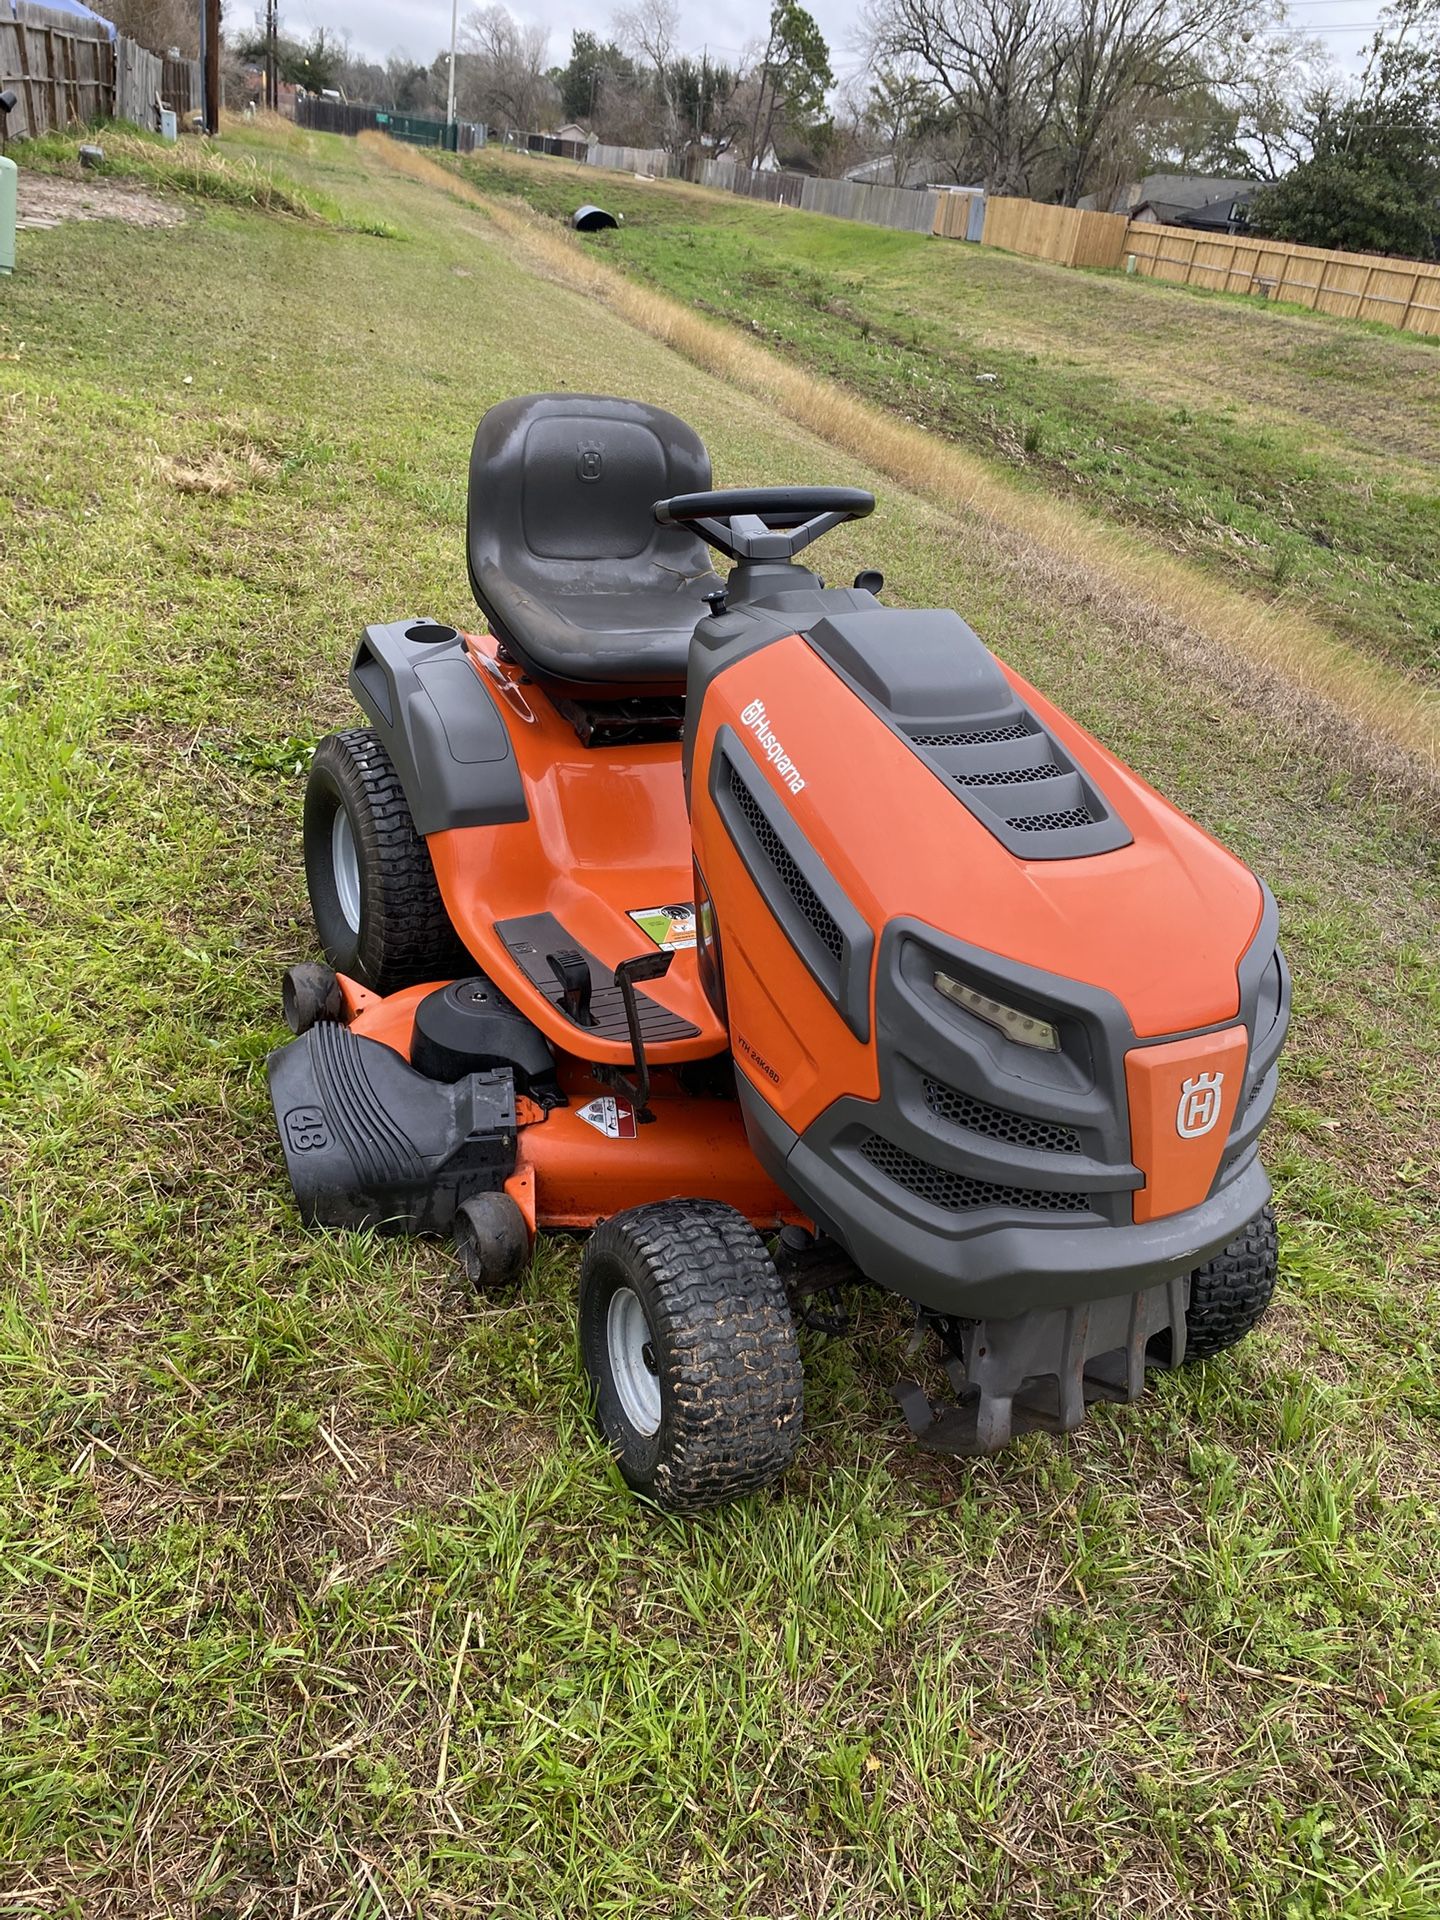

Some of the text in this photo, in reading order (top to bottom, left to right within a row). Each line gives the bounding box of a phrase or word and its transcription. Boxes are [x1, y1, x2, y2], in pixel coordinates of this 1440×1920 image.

[751, 714, 805, 795] Husqvarna
[738, 1036, 750, 1053] YTH
[291, 1113, 328, 1152] 48
